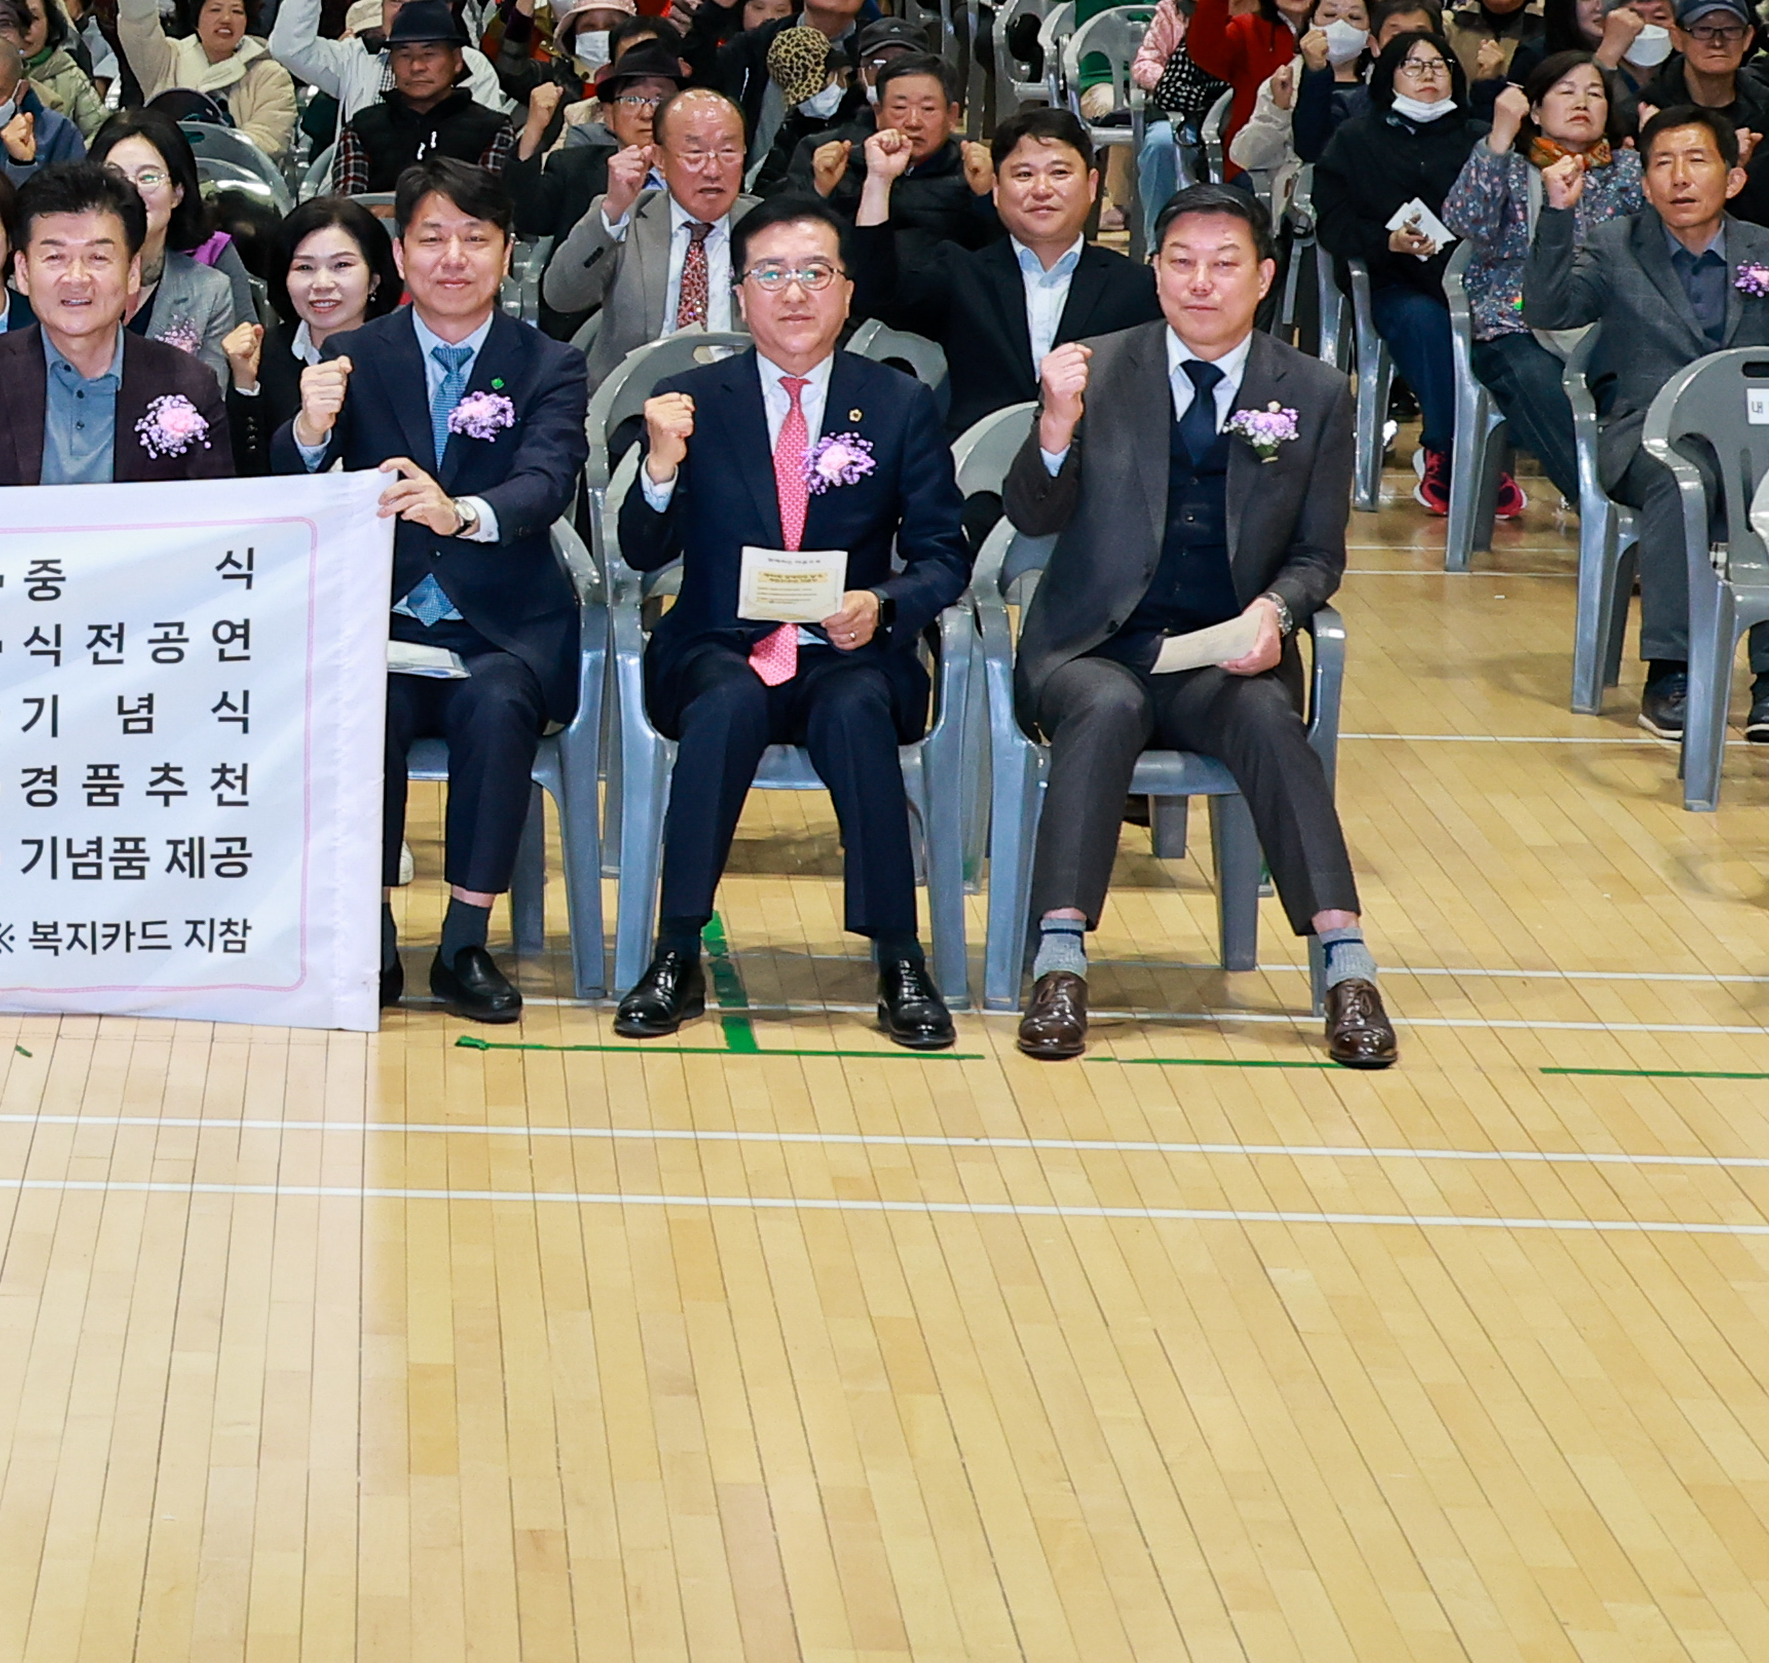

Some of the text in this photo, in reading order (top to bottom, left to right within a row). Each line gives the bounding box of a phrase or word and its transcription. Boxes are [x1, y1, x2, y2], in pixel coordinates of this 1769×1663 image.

[21, 836, 252, 880] 기념품 제공
[29, 918, 252, 956] 복지카드 지참
